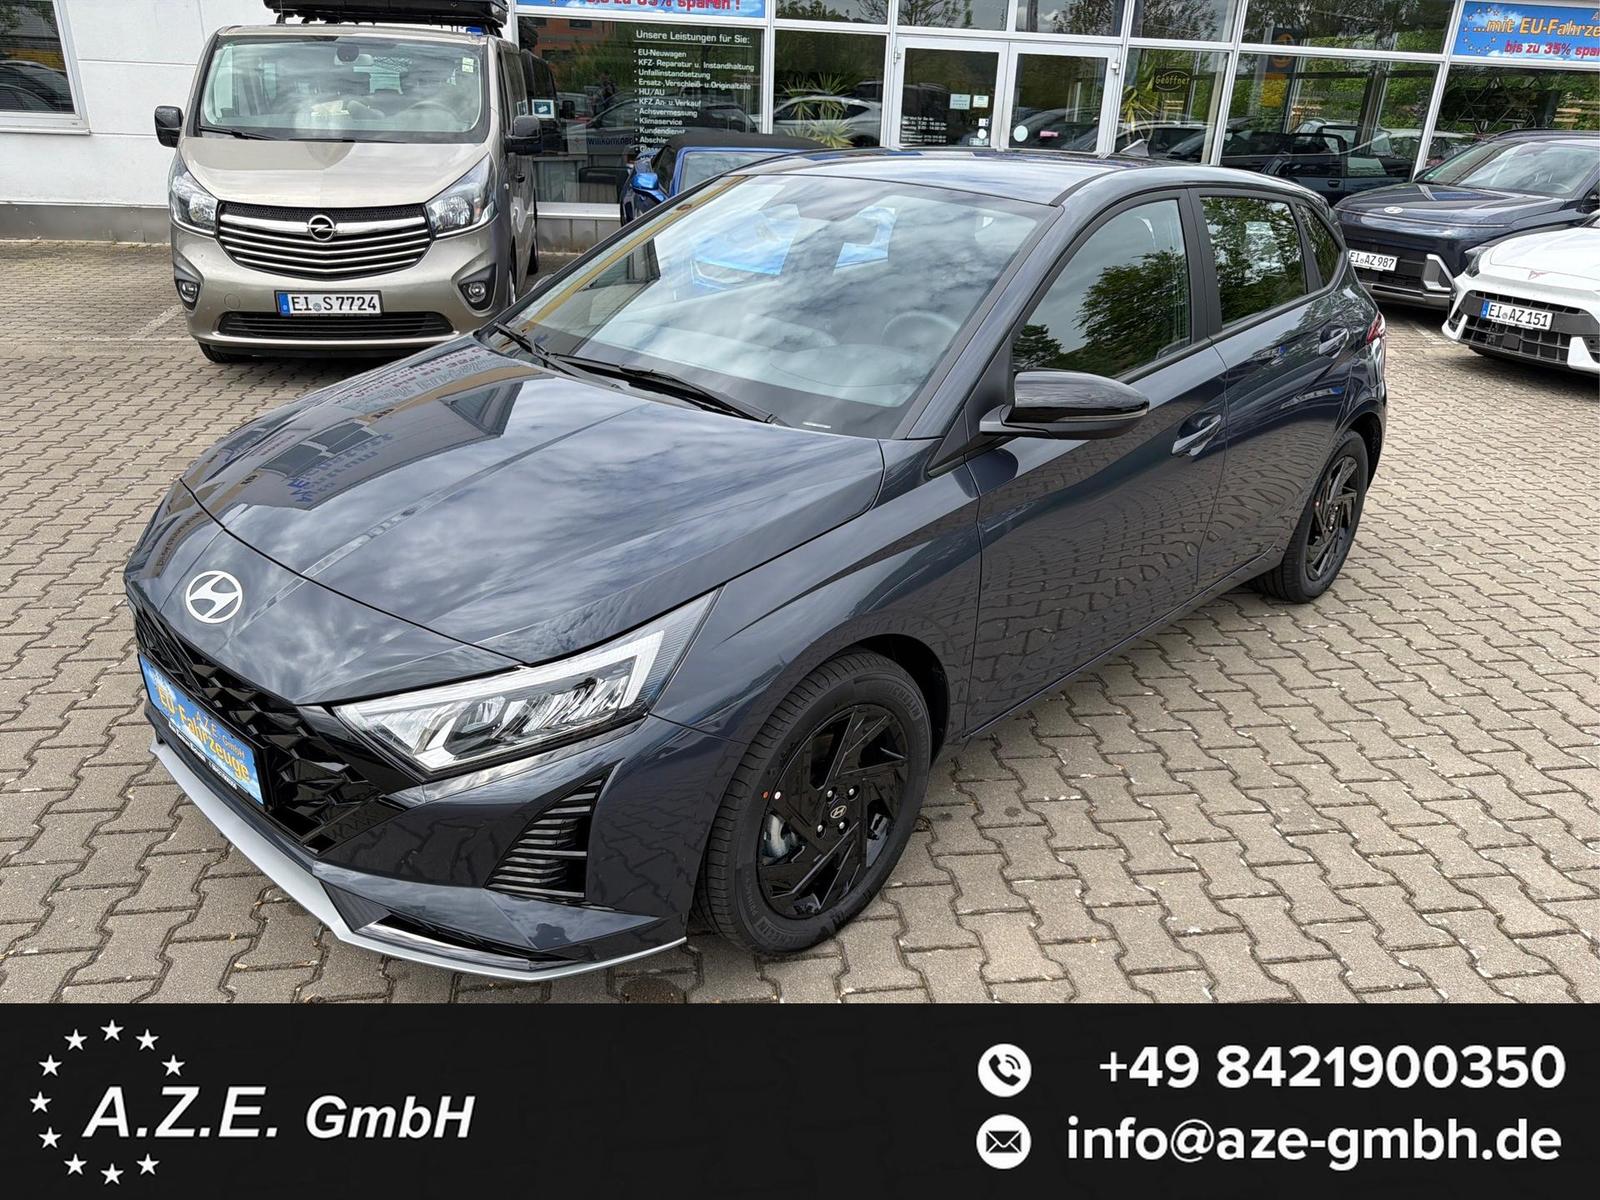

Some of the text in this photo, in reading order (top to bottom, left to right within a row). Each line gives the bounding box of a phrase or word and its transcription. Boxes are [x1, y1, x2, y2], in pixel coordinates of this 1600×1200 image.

[678, 0, 731, 11] sparen
[636, 30, 750, 43] Unsere Leistungen für Sie:
[638, 49, 686, 59] EU-Neuwagen
[1504, 41, 1523, 53] bis
[1526, 43, 1540, 53] zu
[1544, 43, 1571, 55] 35%
[656, 60, 692, 69] Reparatur
[703, 62, 755, 72] Instandhaltung
[638, 69, 710, 80] Unfallinstandsetzung
[639, 88, 665, 96] HU/AU
[639, 108, 697, 118] Achsvermessung
[639, 117, 682, 125] Klimaservice
[1377, 256, 1395, 269] 987
[291, 296, 312, 311] EI
[1488, 304, 1503, 319] EI
[1509, 309, 1525, 323] AZ
[1526, 311, 1549, 328] 151
[158, 686, 250, 782] EU-Fahrzeuge
